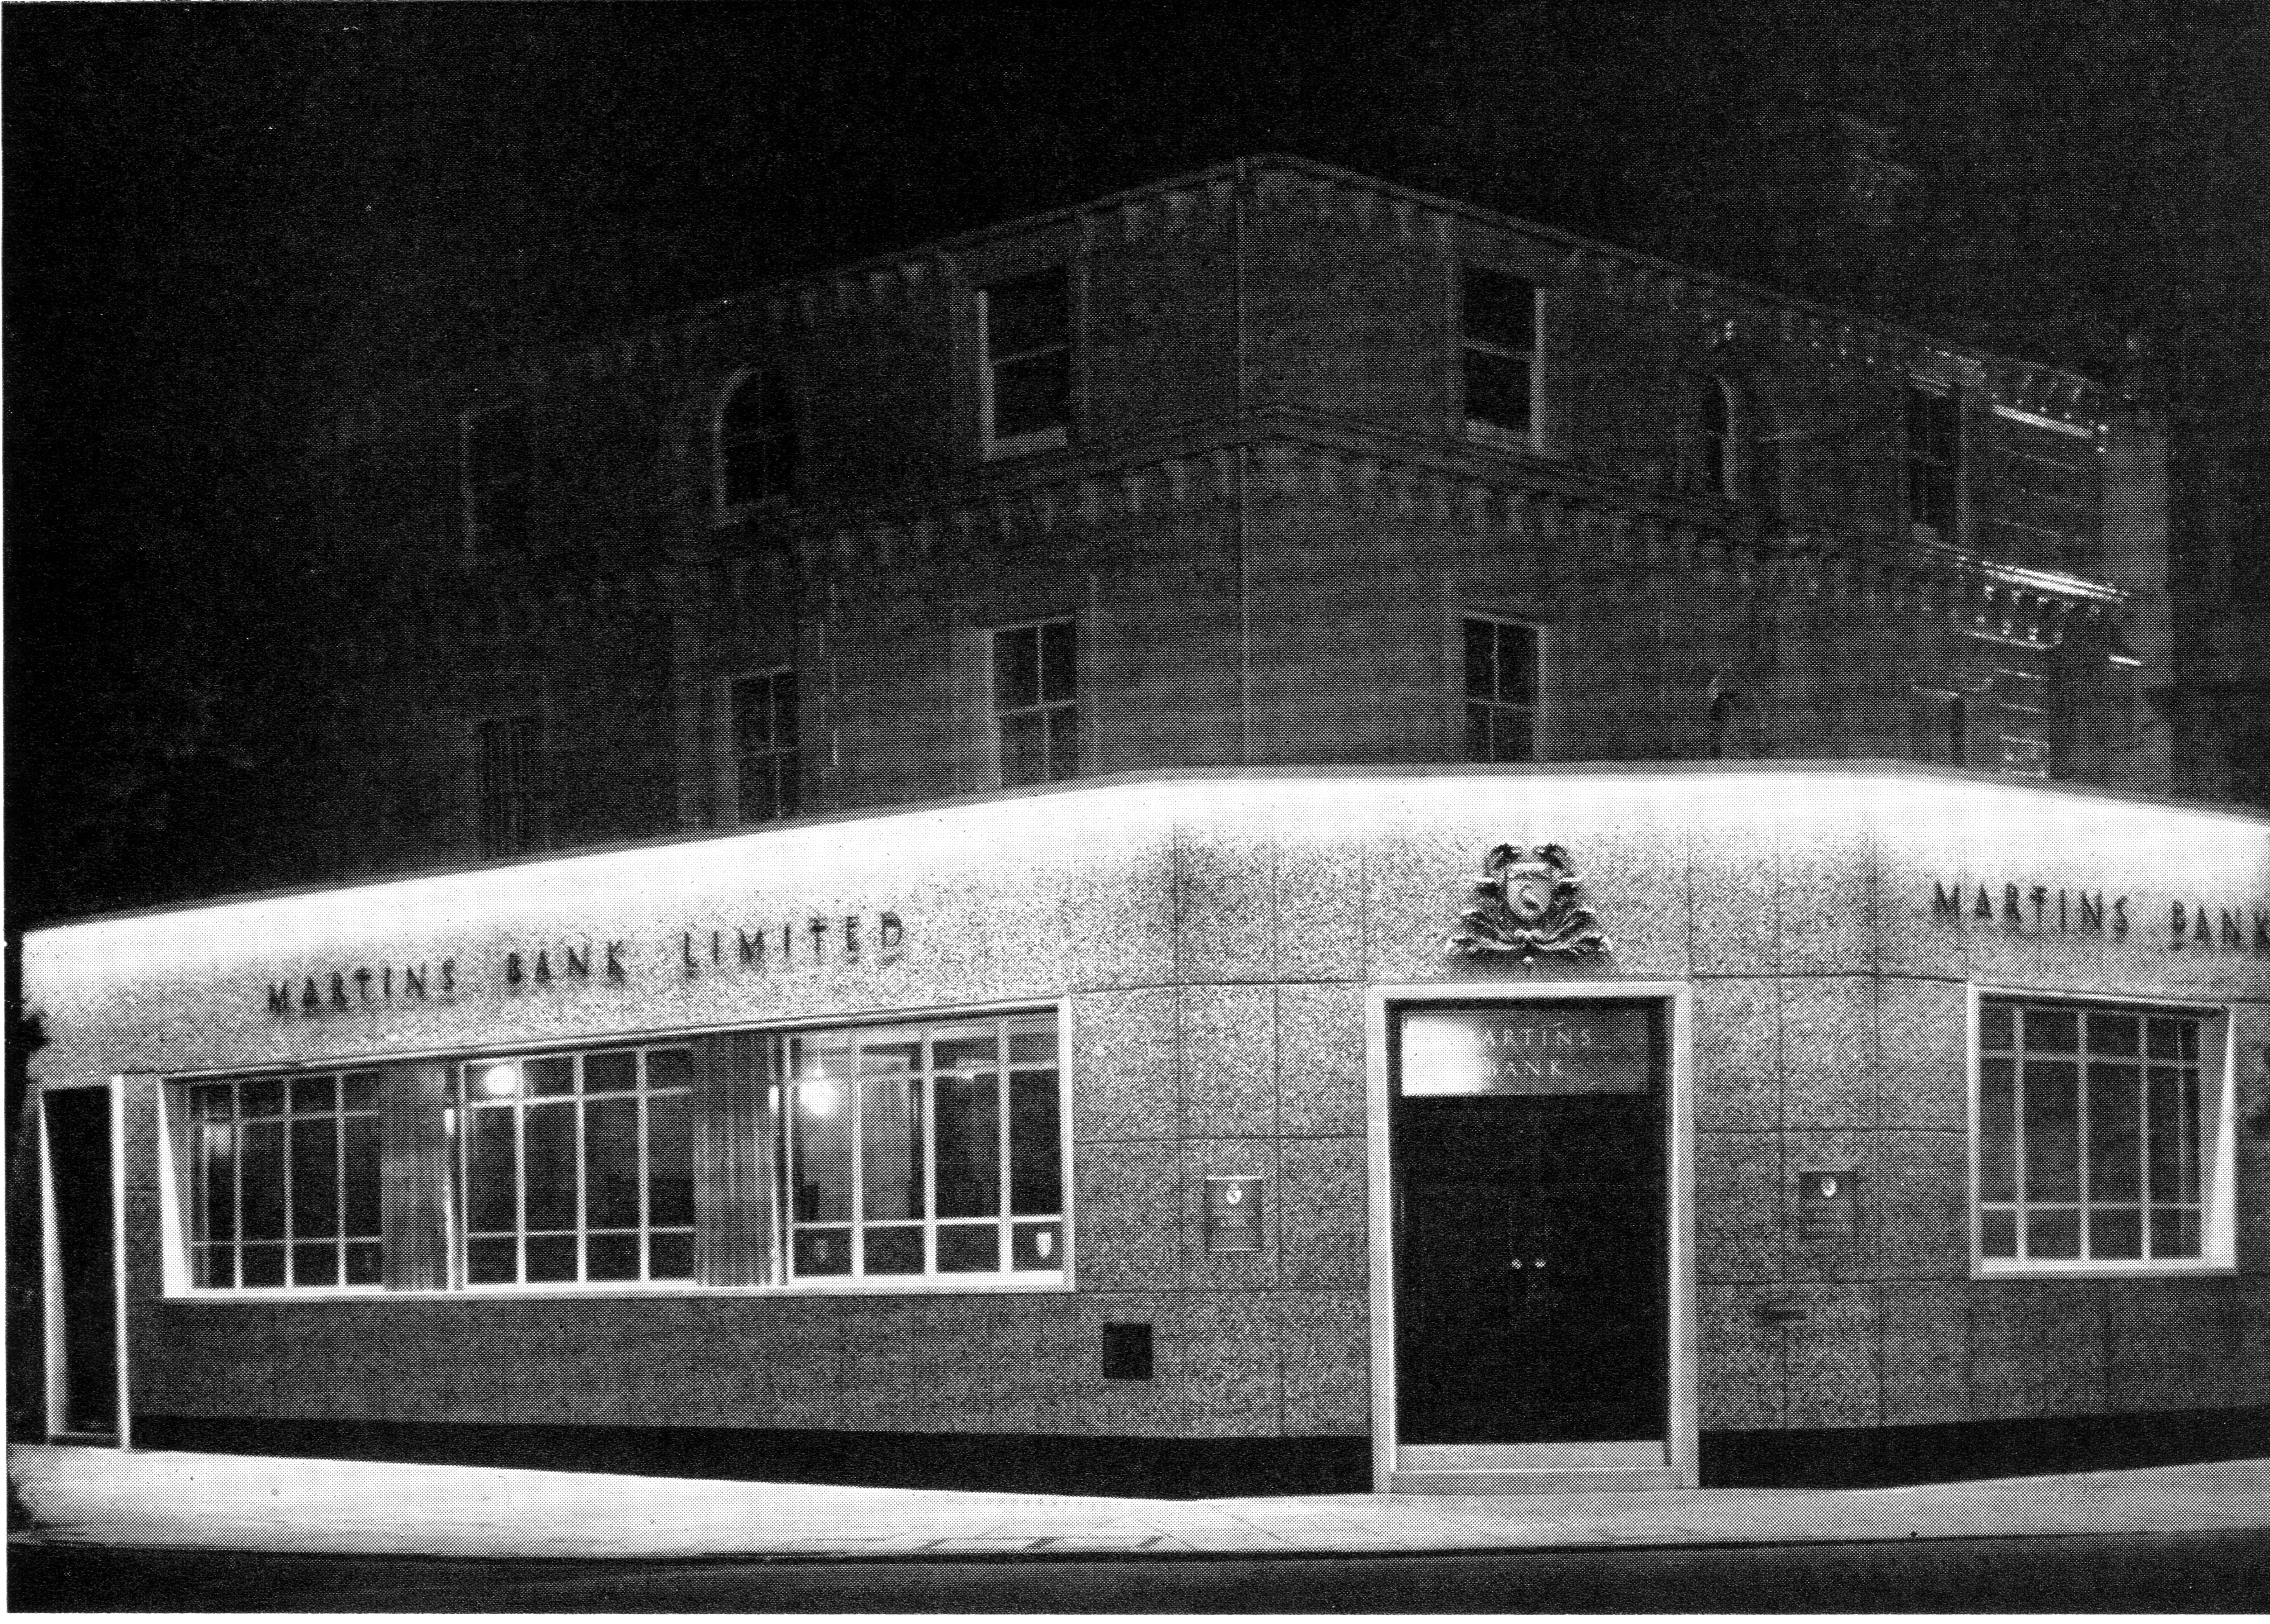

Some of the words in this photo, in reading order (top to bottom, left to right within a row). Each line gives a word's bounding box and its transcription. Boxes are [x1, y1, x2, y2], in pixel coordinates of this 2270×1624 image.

[1933, 881, 2129, 943] MARTINS
[267, 959, 455, 1014] MARTINS
[507, 941, 626, 989] BANK
[683, 911, 903, 972] LIMITED
[1482, 1028, 1591, 1047] ARTINS
